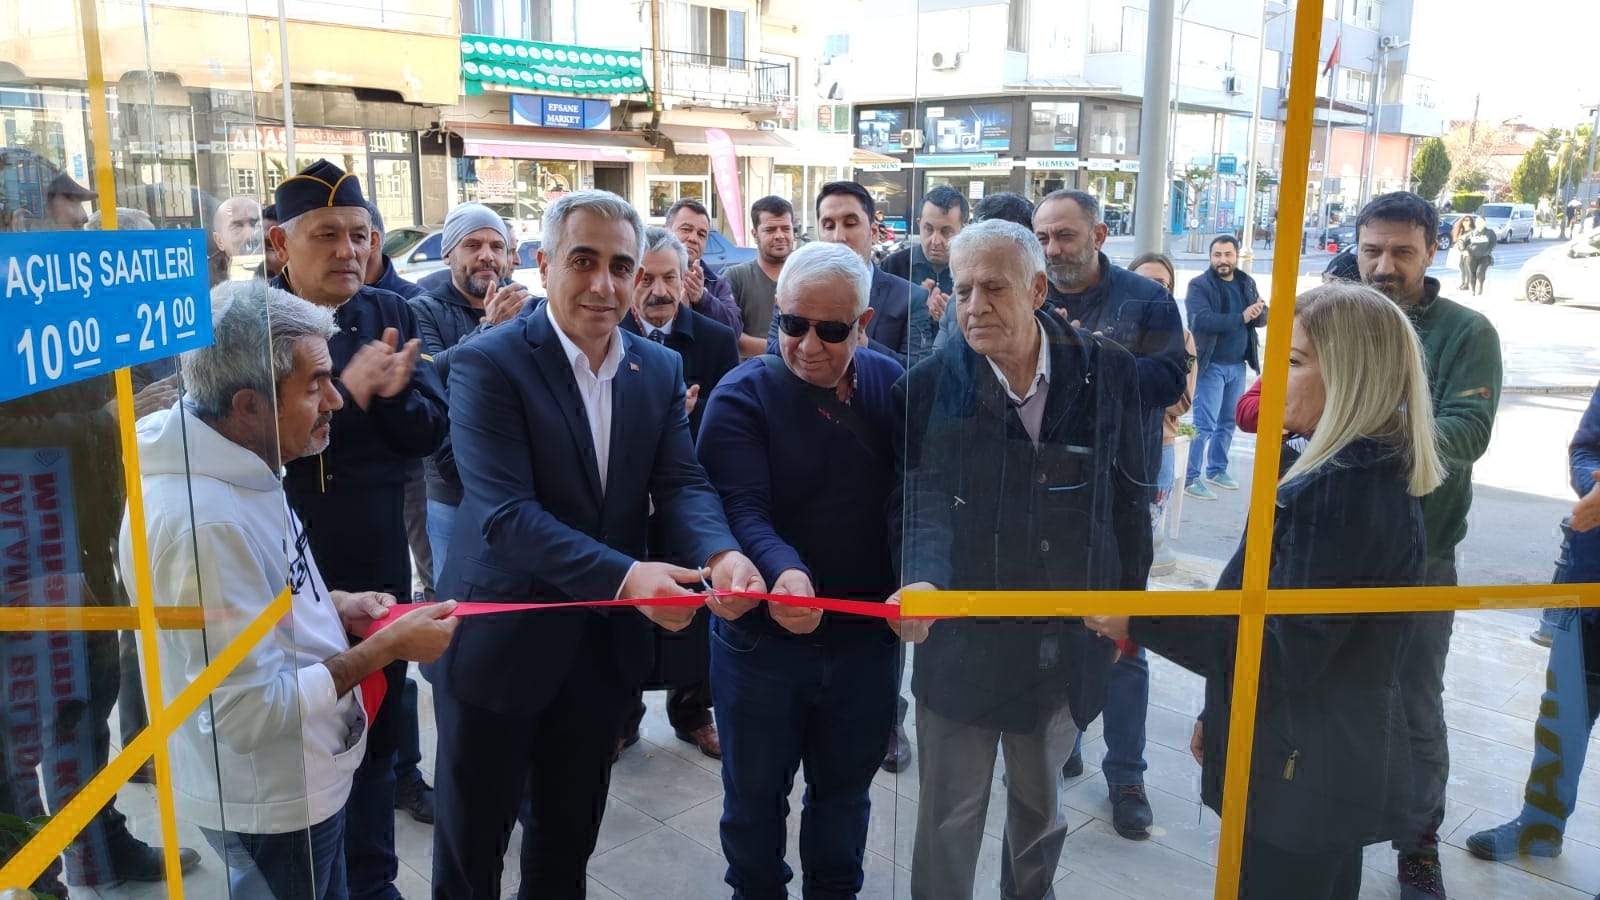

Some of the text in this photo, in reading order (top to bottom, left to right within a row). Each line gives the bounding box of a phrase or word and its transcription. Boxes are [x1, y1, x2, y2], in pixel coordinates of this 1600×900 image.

[548, 103, 579, 113] EFSANE
[546, 114, 580, 124] MARKET
[1036, 160, 1075, 168] SIEMENS
[6, 238, 194, 305] AÇILIŞ SAATLERİ
